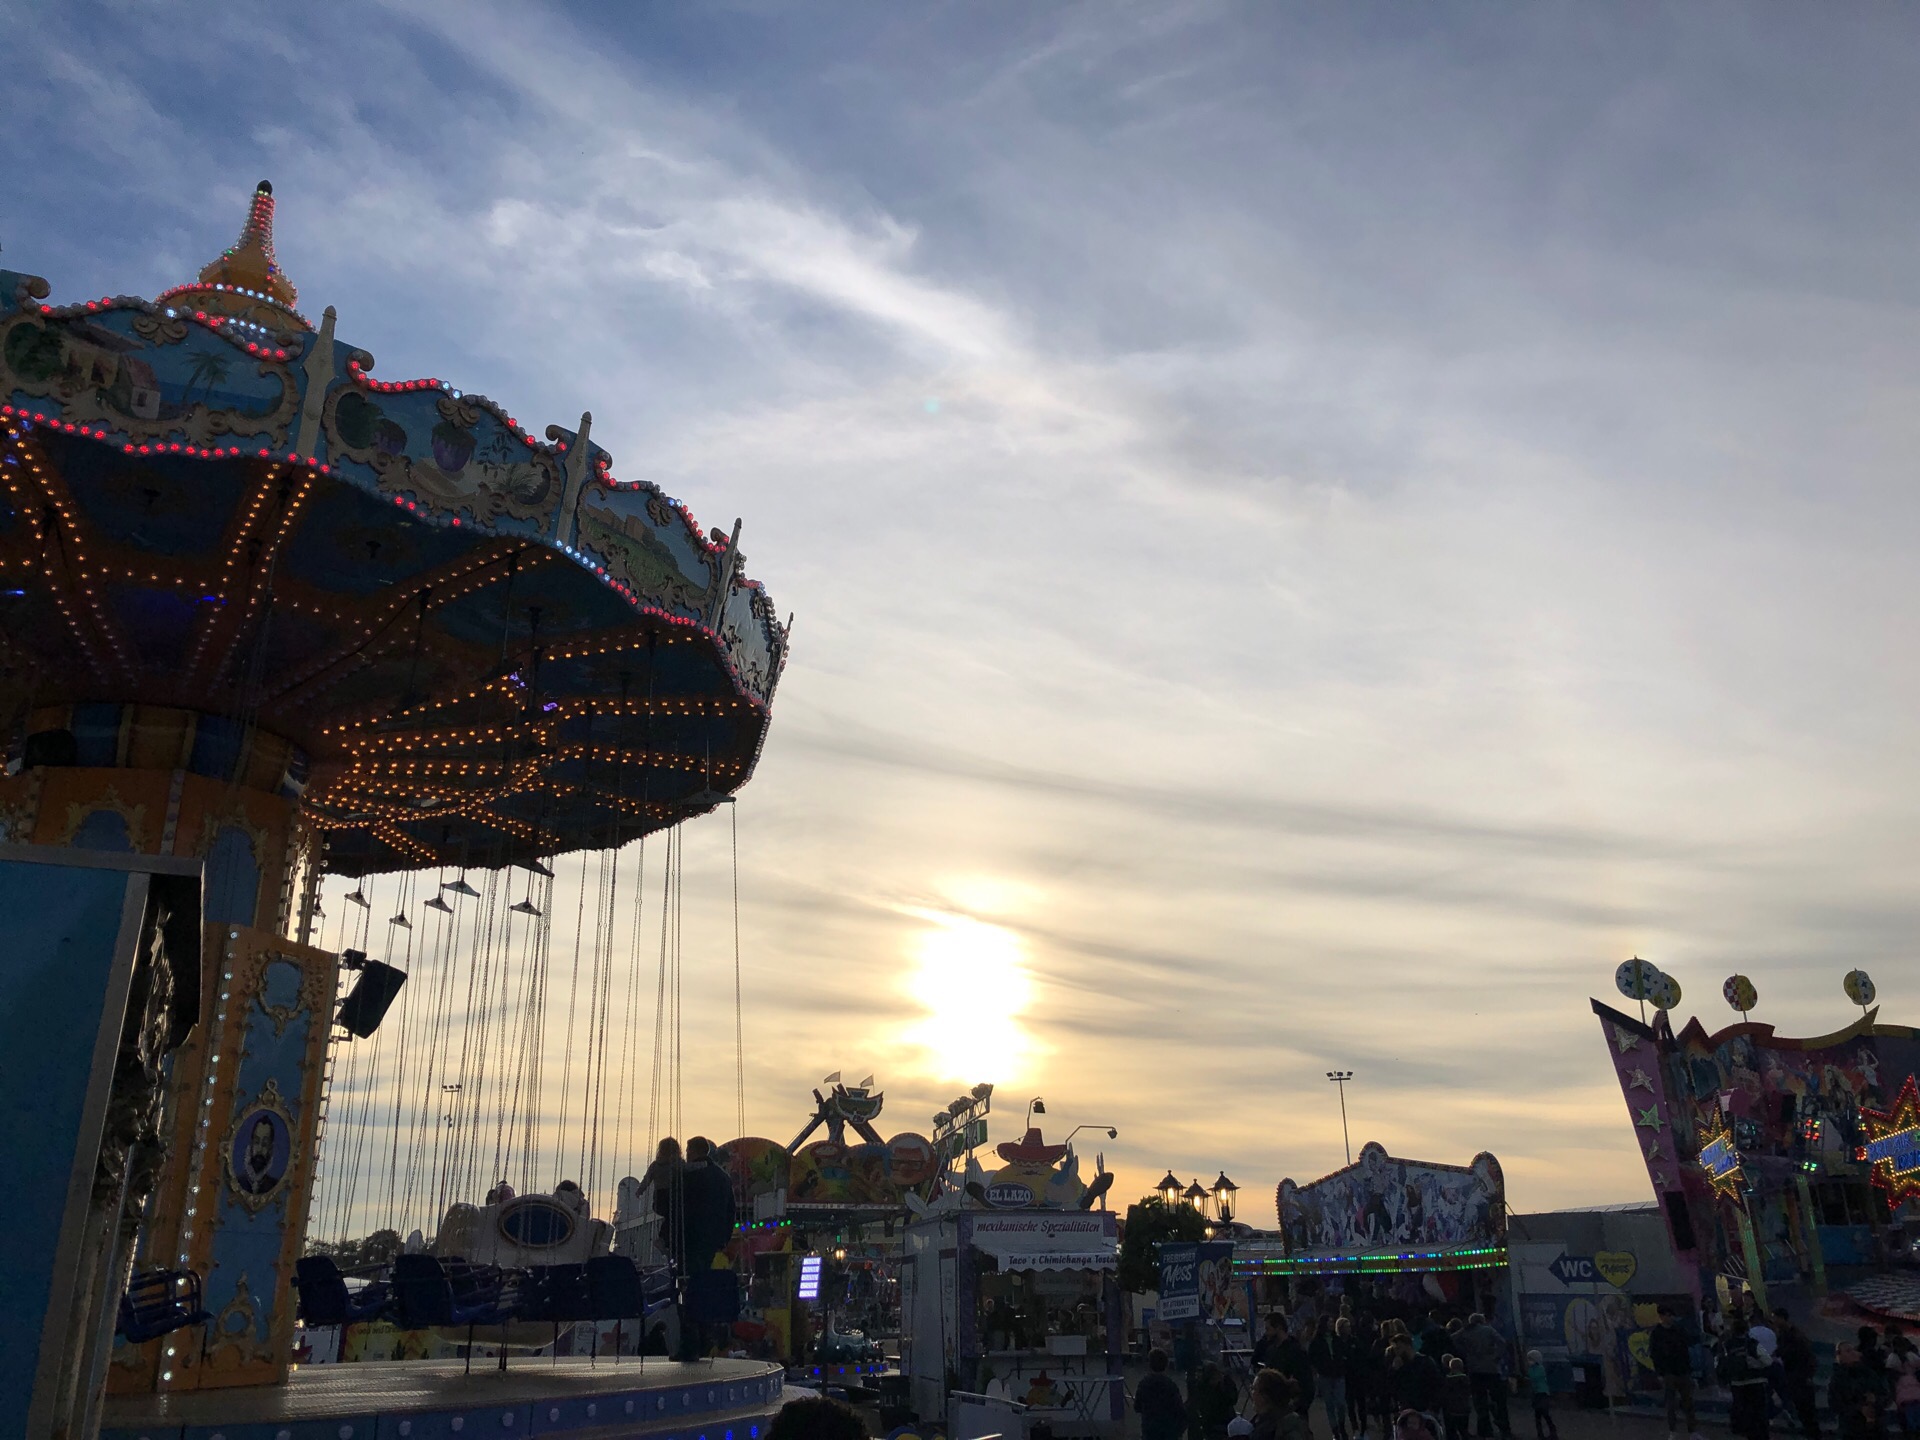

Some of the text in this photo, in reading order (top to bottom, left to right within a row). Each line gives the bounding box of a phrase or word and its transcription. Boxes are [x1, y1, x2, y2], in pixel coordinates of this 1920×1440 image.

[989, 1188, 1031, 1201] EL LAZO
[976, 1220, 1100, 1234] mexikanische Spezialitäten
[1038, 1254, 1092, 1266] Chimichanga
[1560, 1260, 1592, 1278] WC
